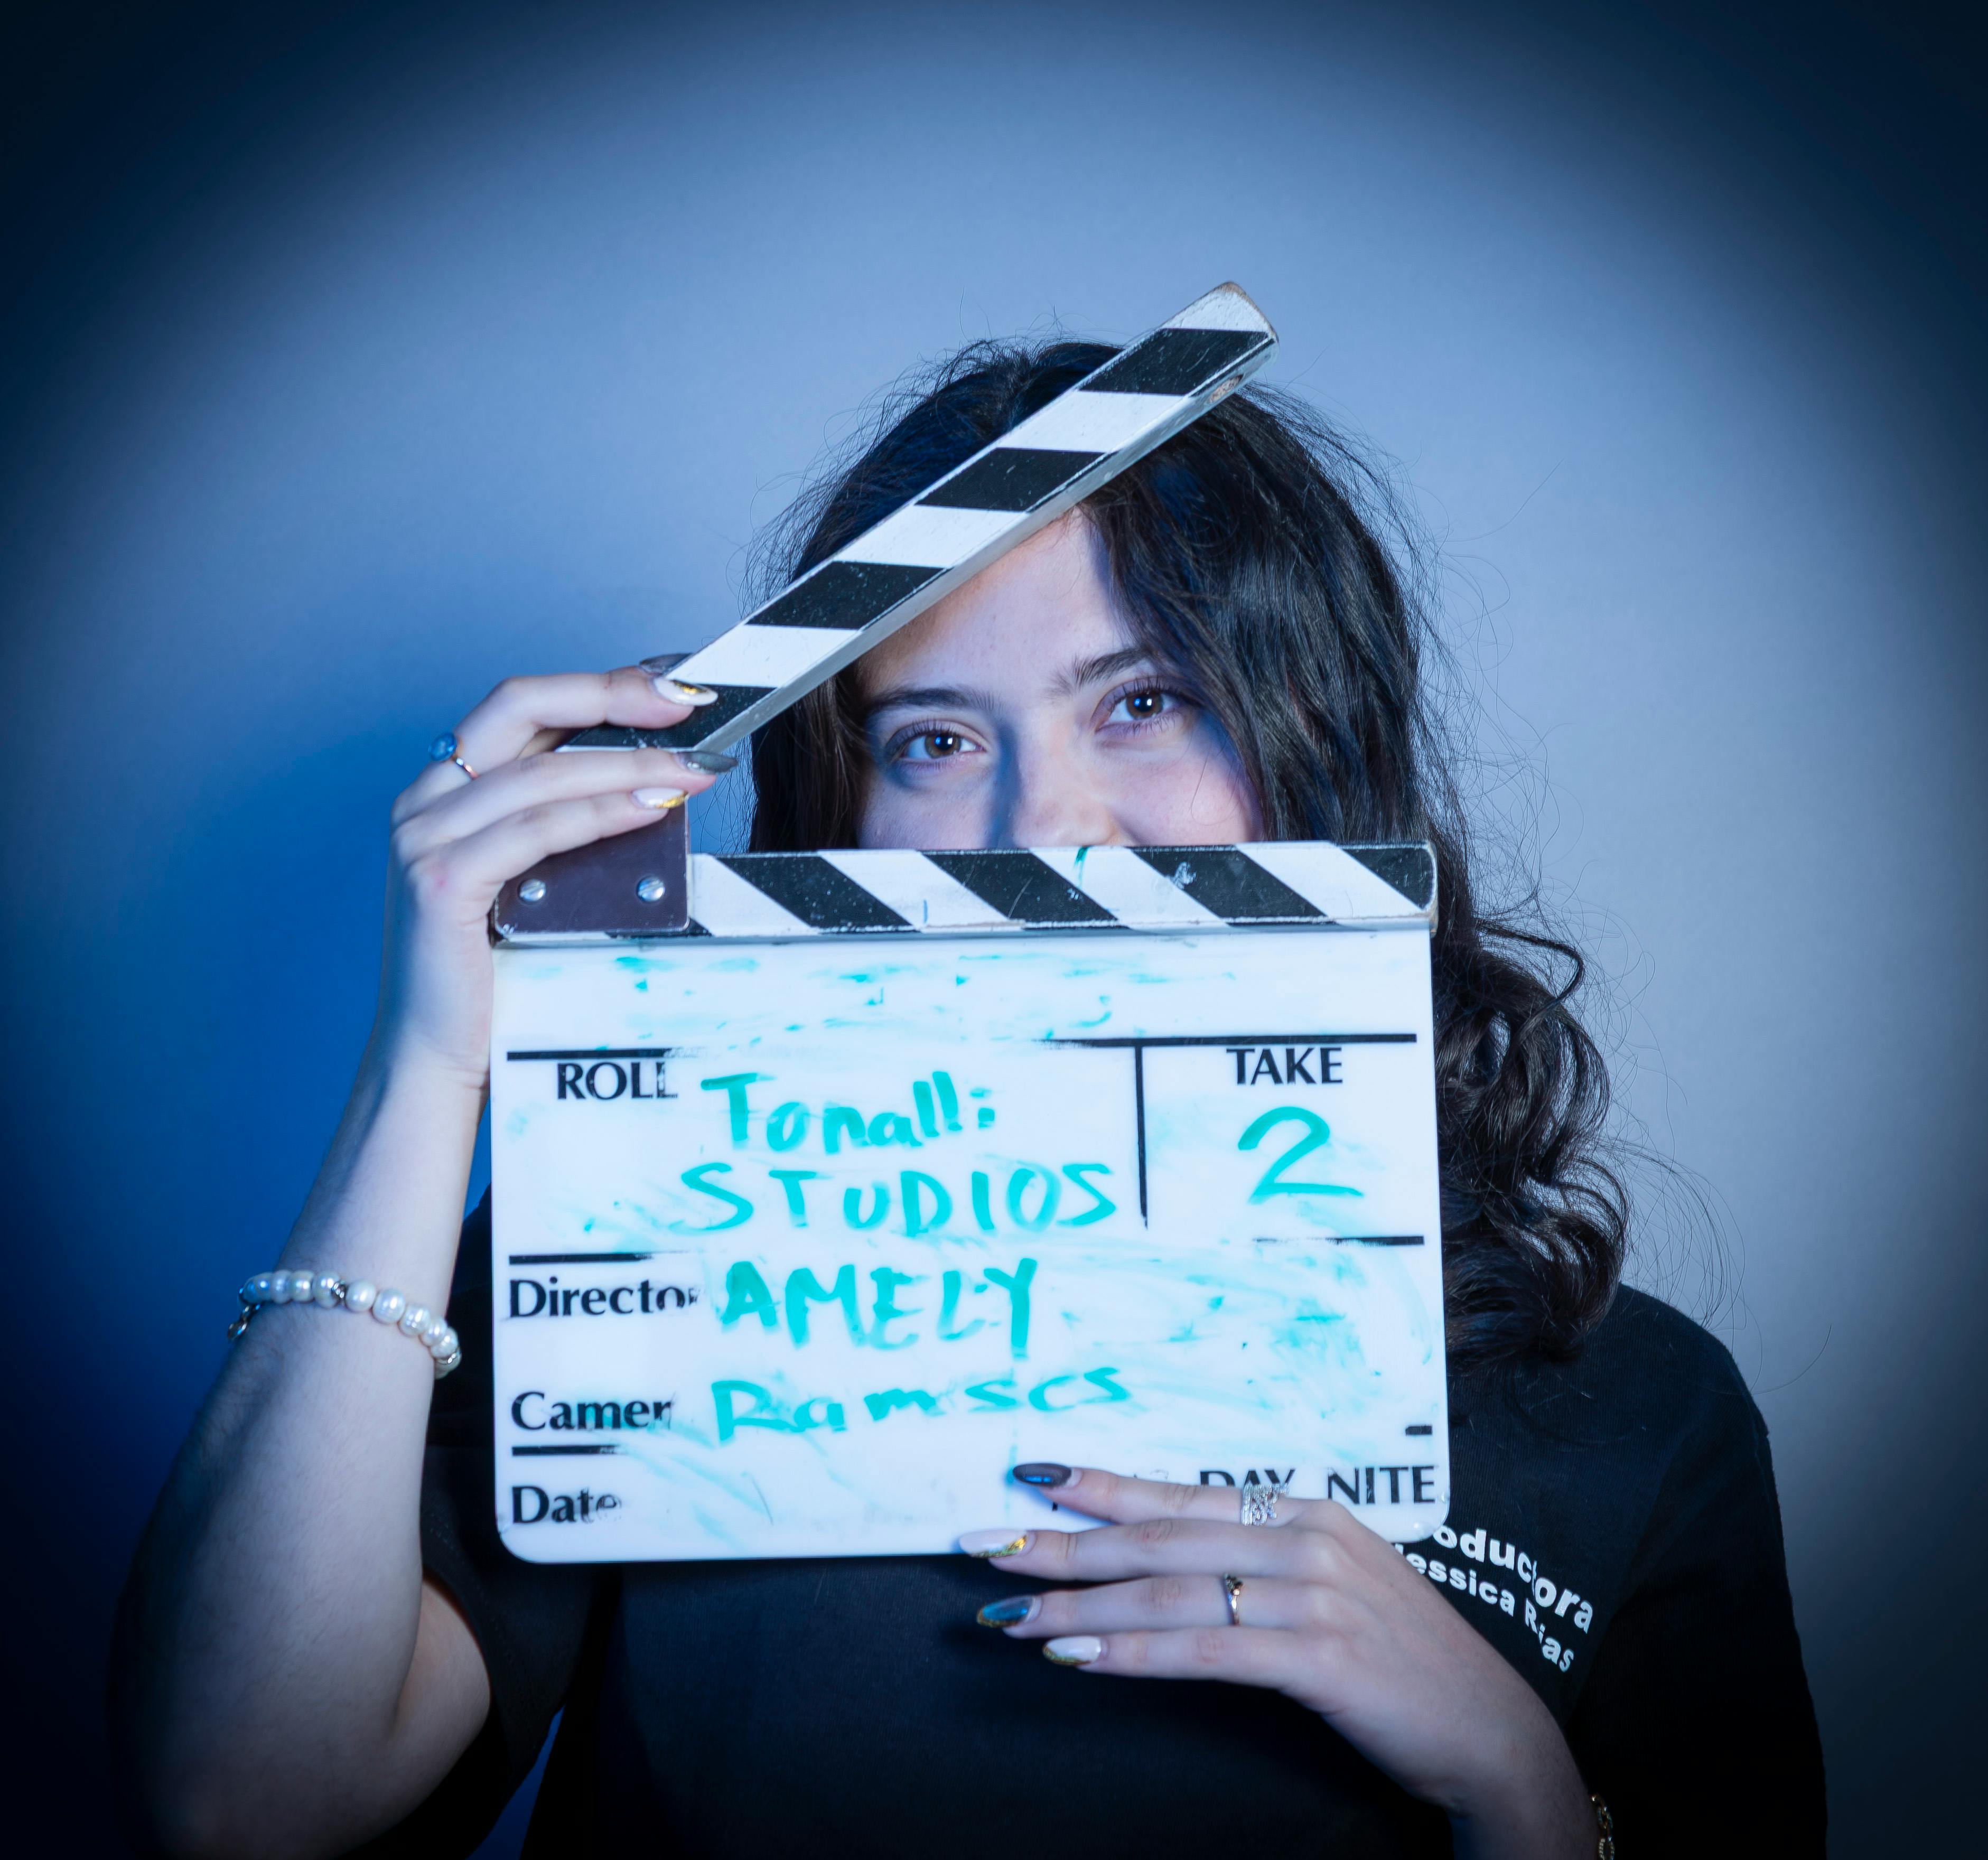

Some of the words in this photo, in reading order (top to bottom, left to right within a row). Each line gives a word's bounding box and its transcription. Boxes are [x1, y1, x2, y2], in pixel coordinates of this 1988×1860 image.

[556, 1062, 678, 1100] ROLL
[1226, 1047, 1343, 1085] TAKE
[1237, 1106, 1364, 1204] 2
[668, 1162, 1116, 1237] STUDIOS
[715, 1257, 1038, 1360] AMELY
[511, 1485, 621, 1523] Date
[1327, 1465, 1436, 1504] NITE
[1395, 1543, 1516, 1617] essica
